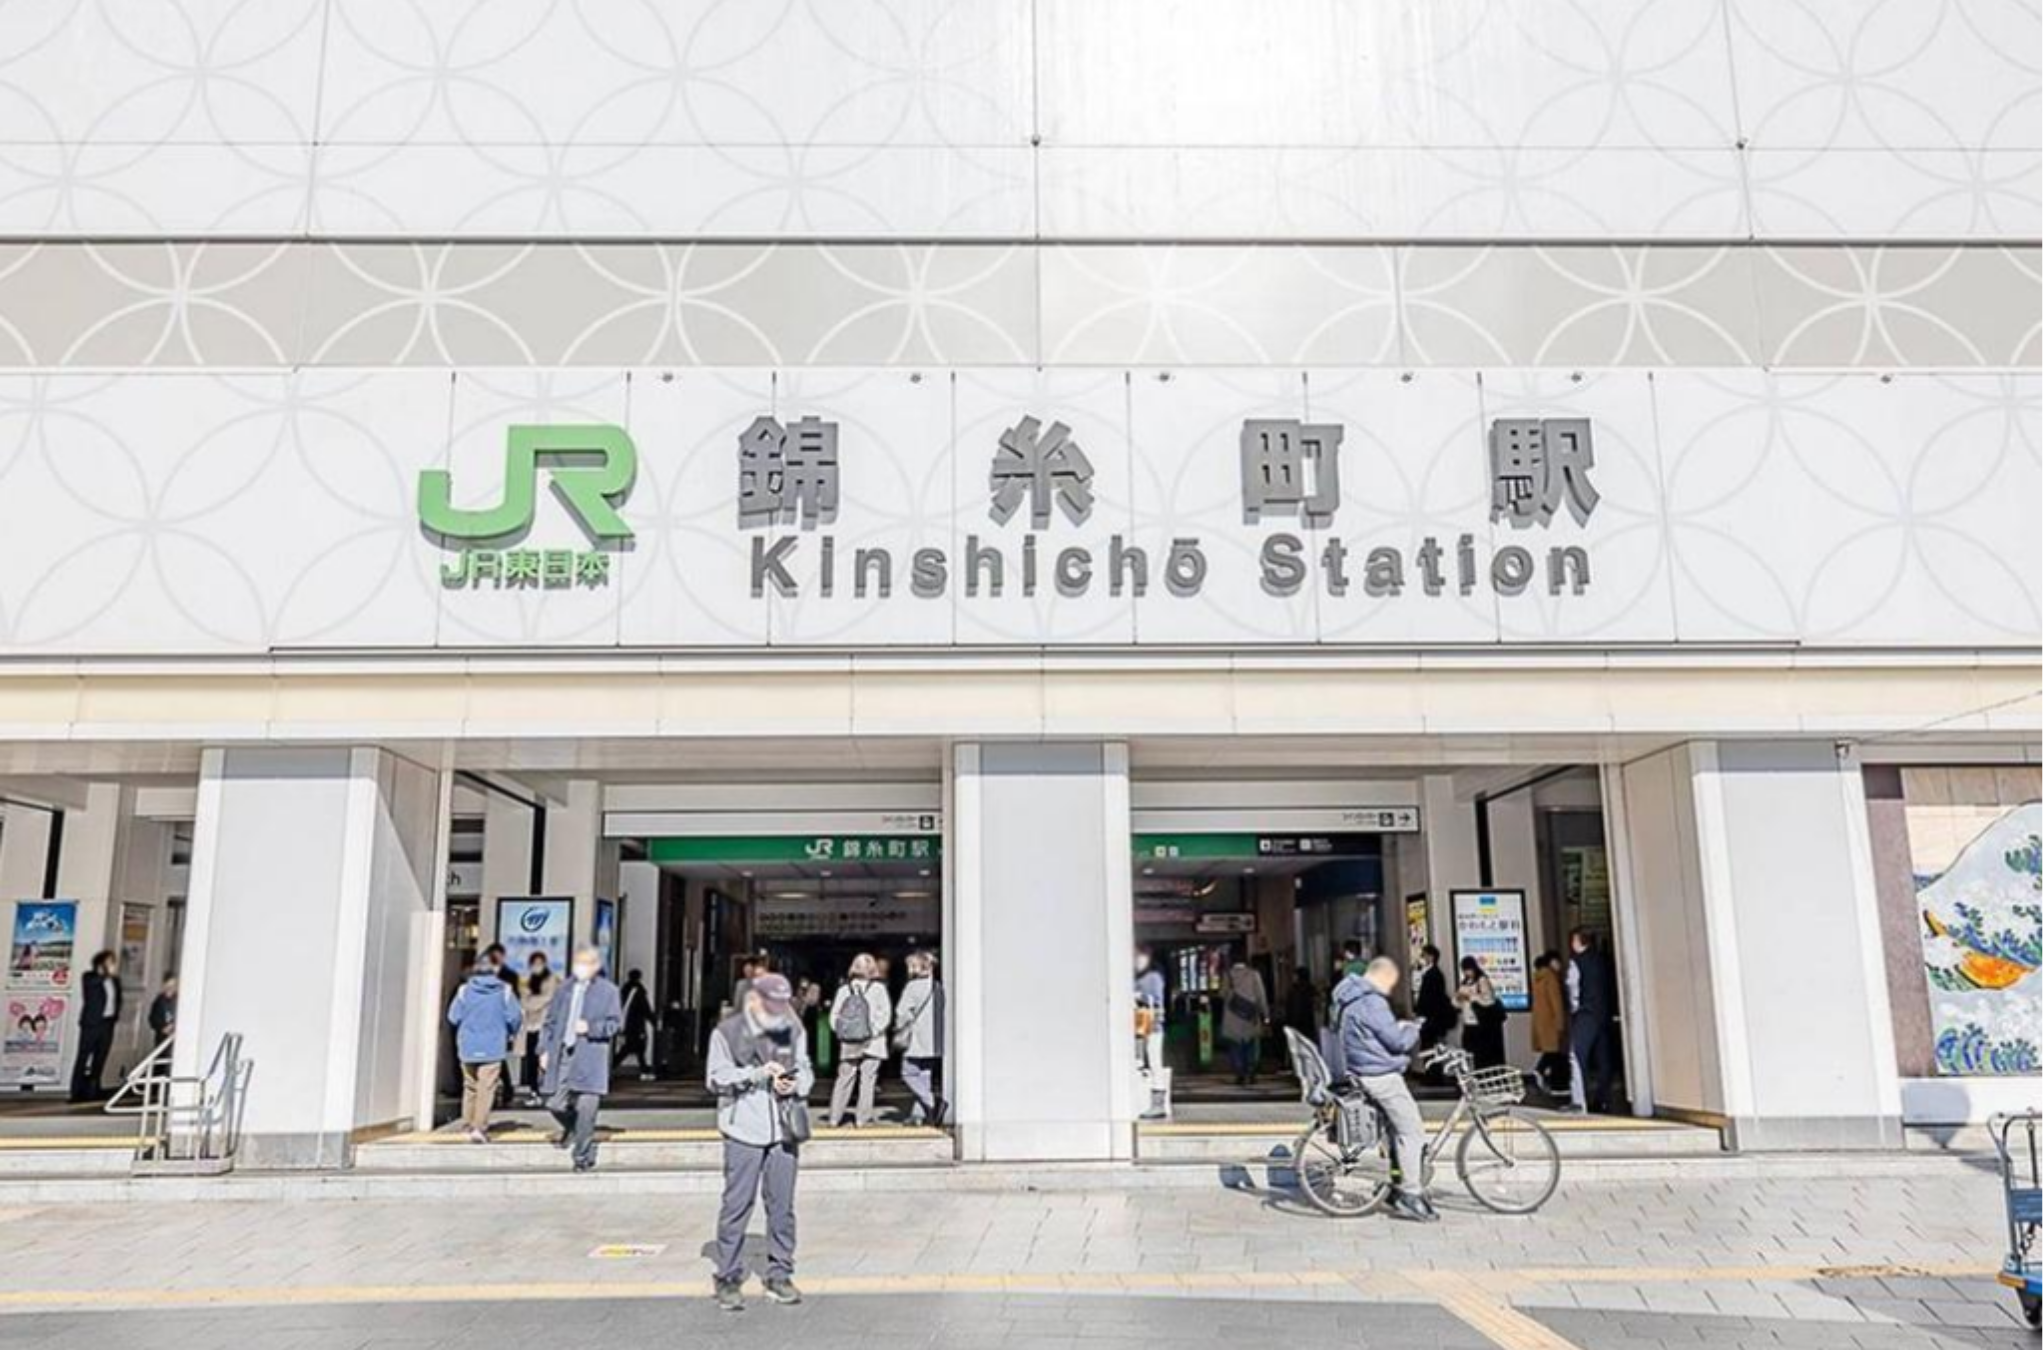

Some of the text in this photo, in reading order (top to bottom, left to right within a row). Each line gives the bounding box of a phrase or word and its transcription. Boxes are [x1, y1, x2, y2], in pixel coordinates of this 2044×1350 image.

[417, 424, 638, 550] JR
[737, 415, 1601, 531] 錦糸町駅
[439, 548, 610, 590] JR東日本
[750, 532, 1592, 599] Kinshichō Station
[805, 838, 930, 858] JR 錦糸町駅
